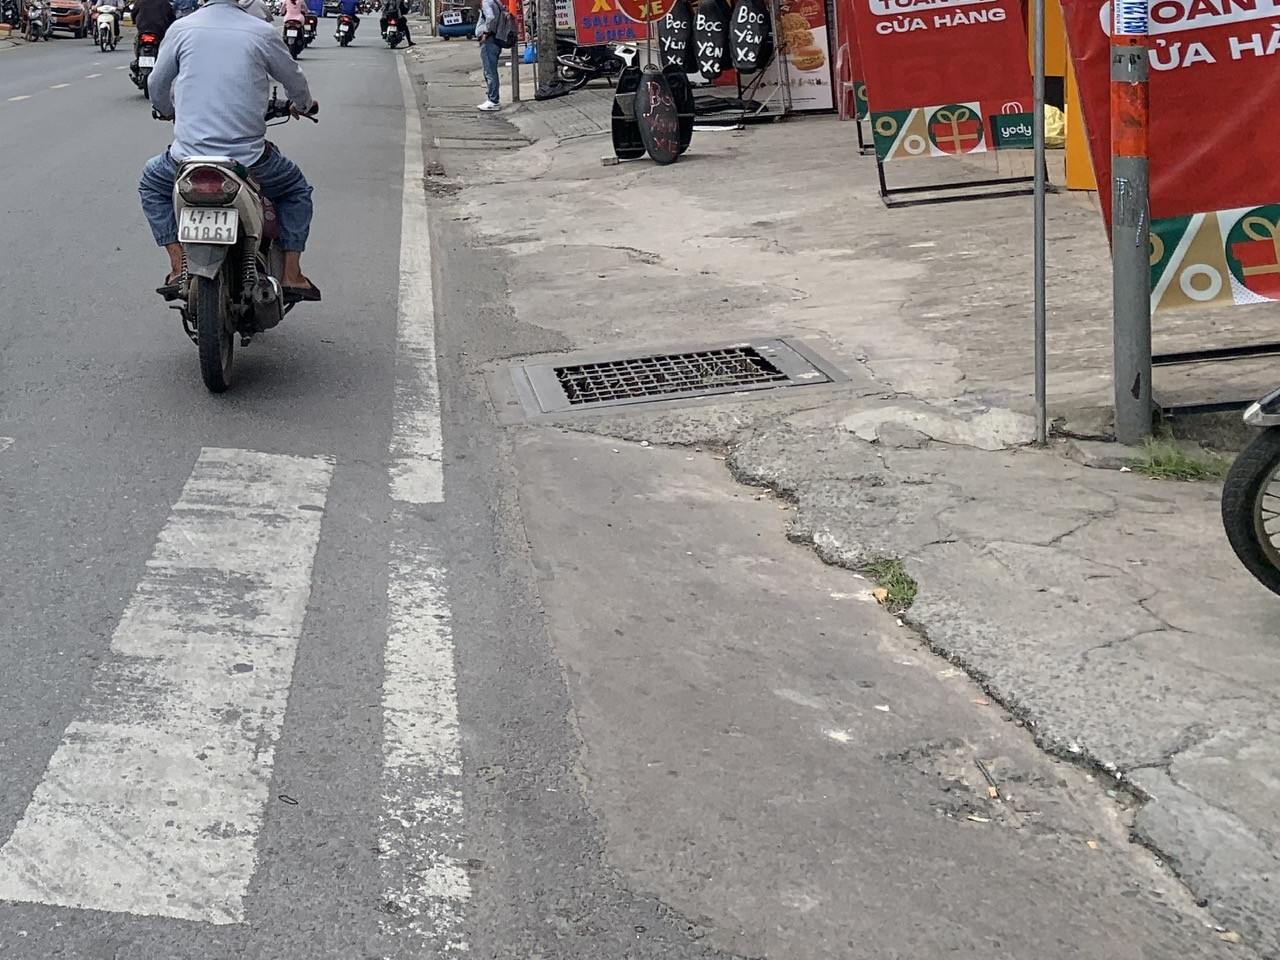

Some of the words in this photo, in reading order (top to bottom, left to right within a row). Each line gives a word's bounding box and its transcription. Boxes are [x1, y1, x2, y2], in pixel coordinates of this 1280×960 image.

[639, 0, 664, 19] XE
[876, 15, 928, 35] CỬA
[934, 8, 1007, 29] HÀNG
[1147, 38, 1216, 71] ỬA
[1001, 123, 1032, 138] yody
[189, 209, 228, 224] 47-T1
[182, 226, 234, 240] 01861
